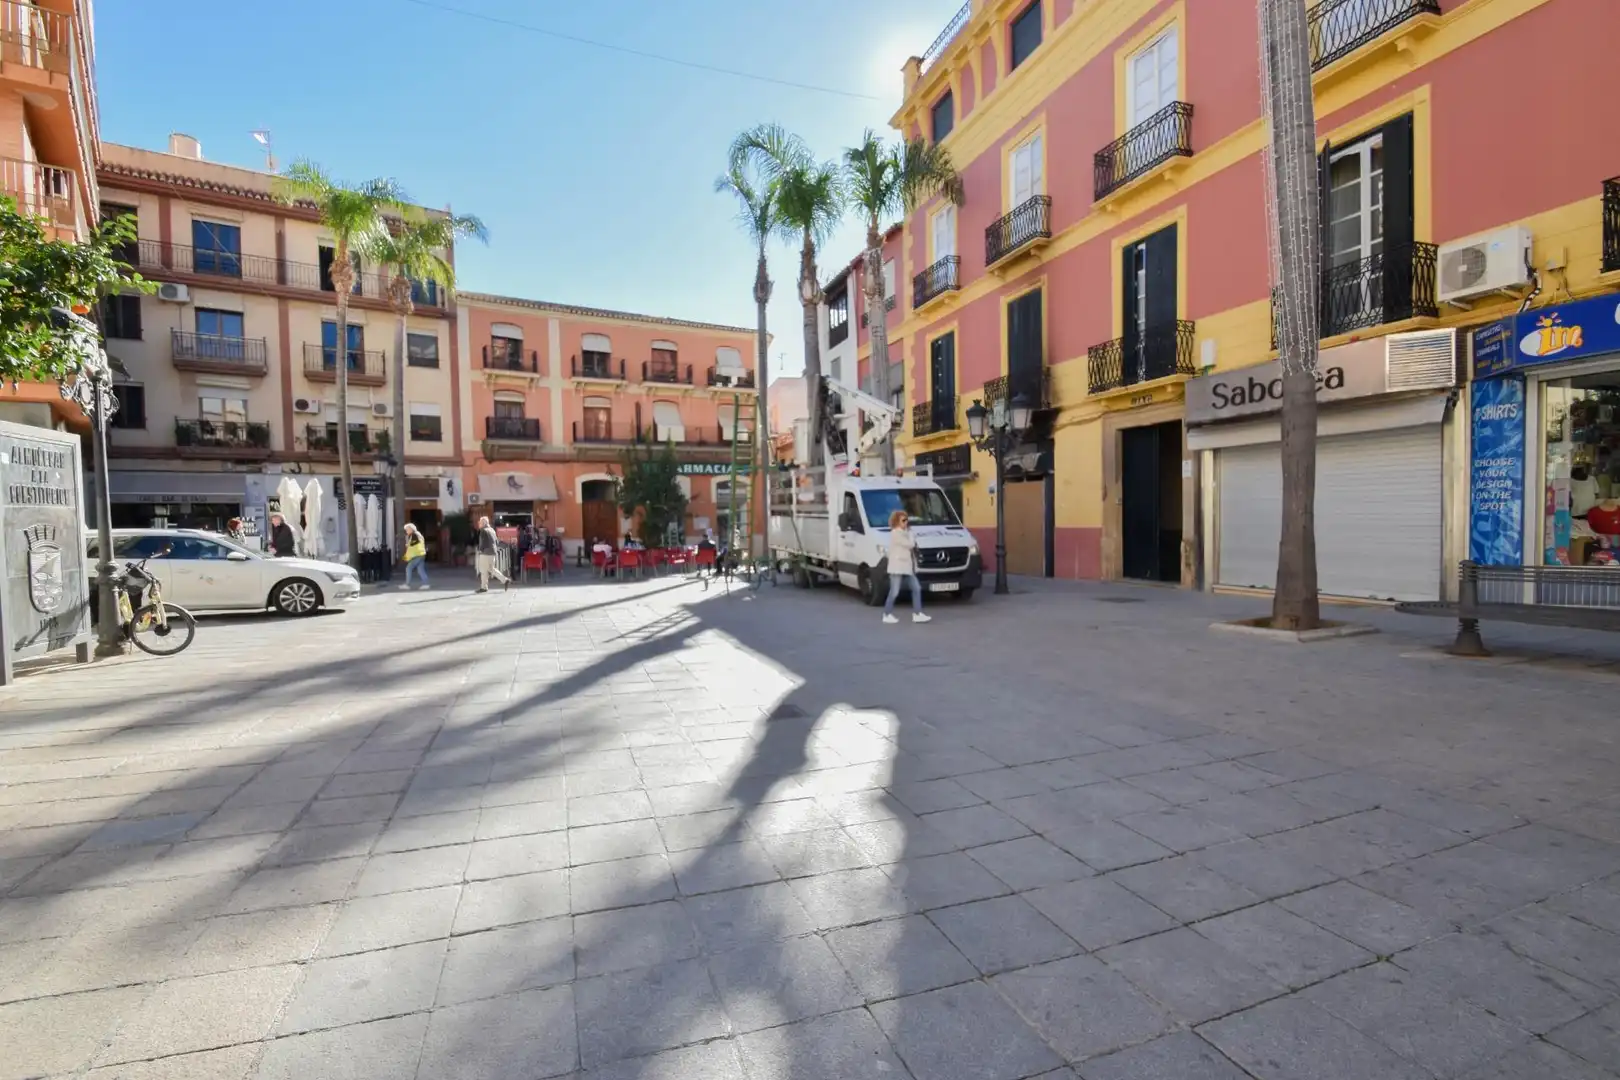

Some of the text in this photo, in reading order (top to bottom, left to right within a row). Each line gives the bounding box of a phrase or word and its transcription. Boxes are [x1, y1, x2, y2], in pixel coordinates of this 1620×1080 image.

[1210, 366, 1345, 410] Saboea
[1474, 457, 1516, 468] CHOOSE
[677, 464, 732, 473] ARMACIA
[1479, 469, 1508, 478] YOUR
[1475, 479, 1513, 489] DESIGN
[1480, 501, 1506, 510] SPOT
